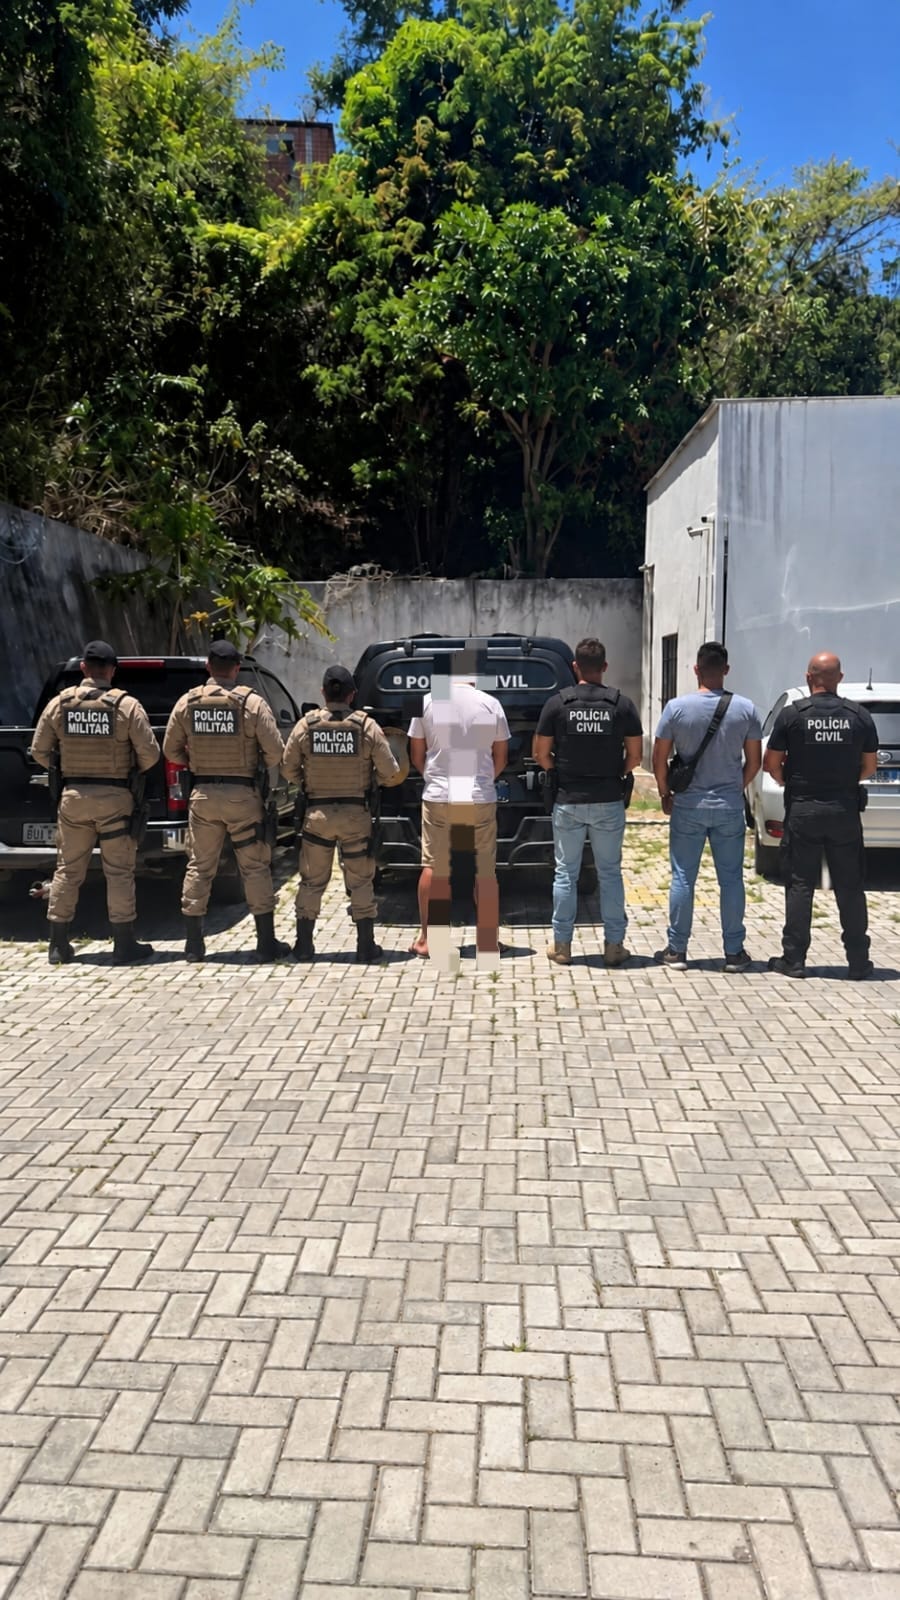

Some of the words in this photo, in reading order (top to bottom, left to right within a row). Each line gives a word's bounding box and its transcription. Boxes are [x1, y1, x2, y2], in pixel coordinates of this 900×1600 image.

[495, 675, 528, 688] IVIL
[67, 709, 109, 723] POLÍCIA
[194, 708, 234, 721] POLÍCIA
[569, 708, 610, 721] POLÍCIA
[67, 723, 109, 735] MILITAR
[194, 722, 234, 733] MILITAR
[576, 721, 604, 733] CIVIL
[807, 716, 850, 730] POLÍCIA
[313, 730, 354, 742] POLÍCIA
[815, 731, 844, 742] CIVIL
[313, 742, 354, 753] MILITAR
